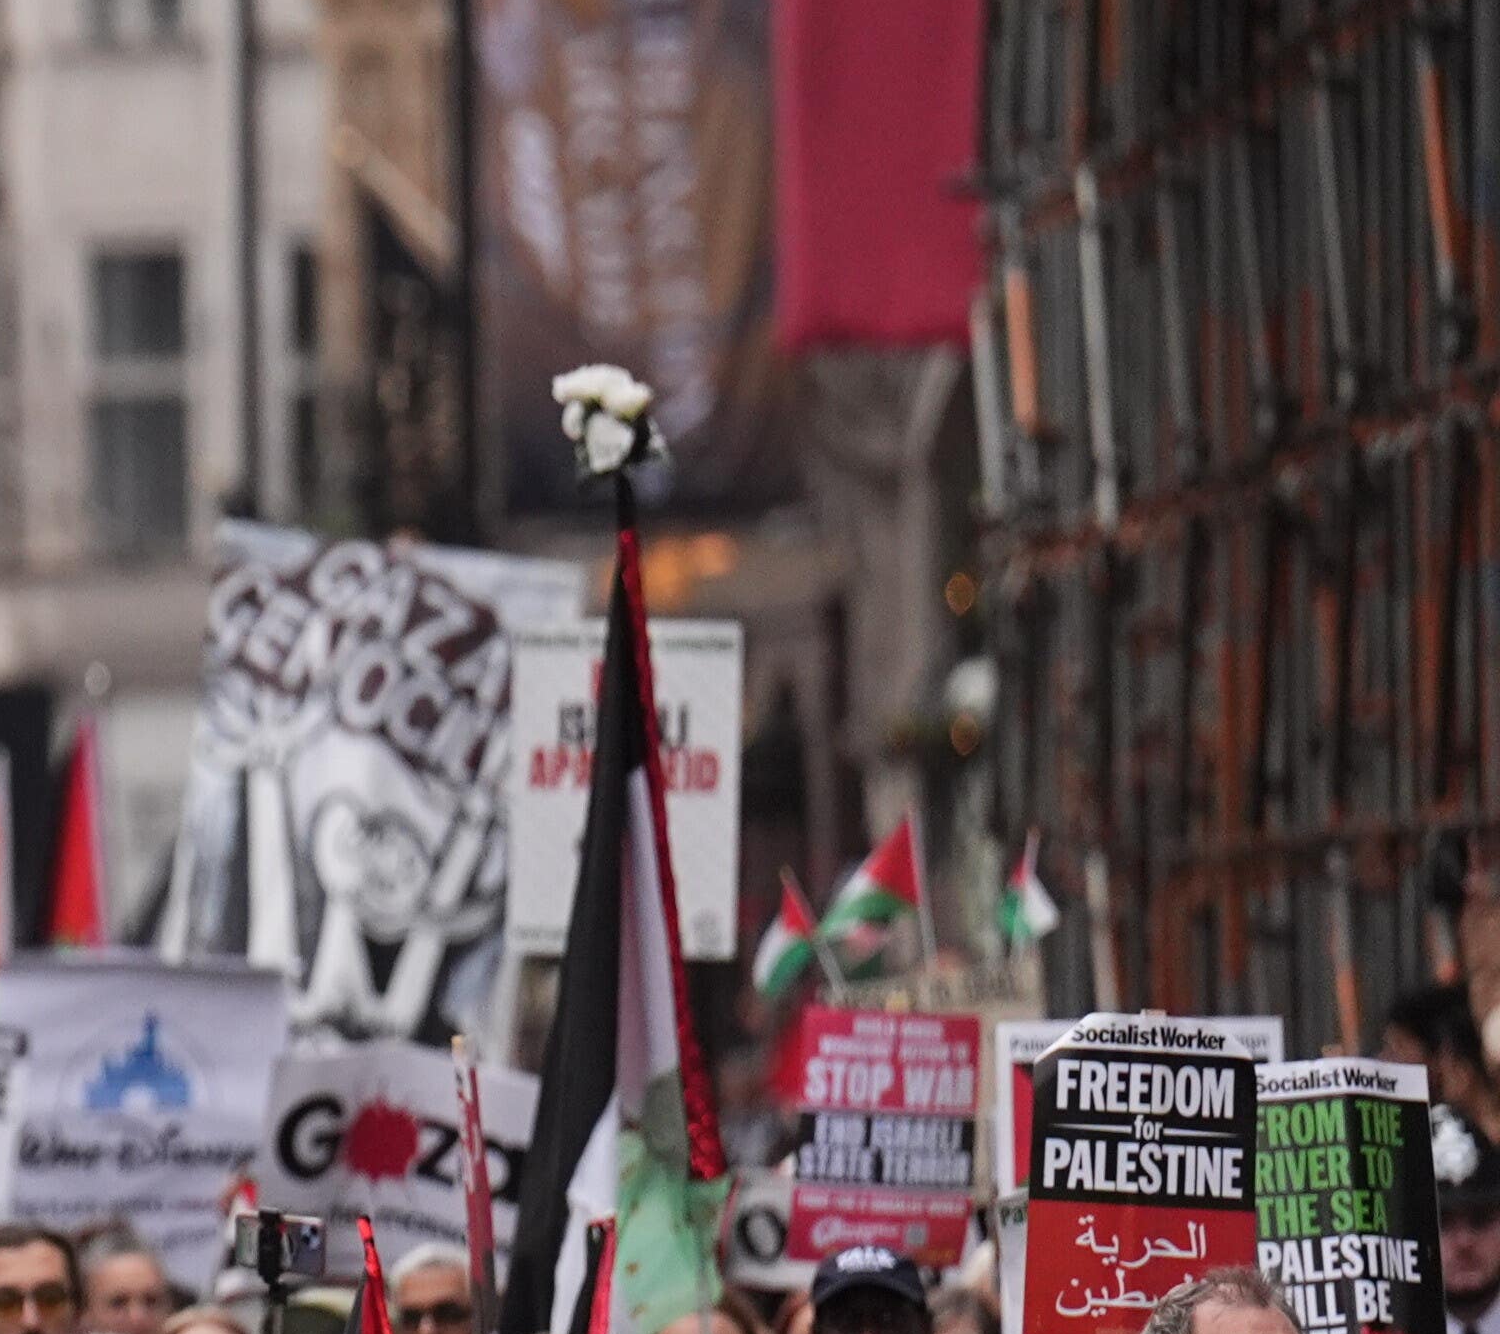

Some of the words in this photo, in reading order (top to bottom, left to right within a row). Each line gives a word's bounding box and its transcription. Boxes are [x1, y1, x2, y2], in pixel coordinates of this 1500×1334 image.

[1071, 1026, 1157, 1046] Socialist
[1160, 1028, 1226, 1051] Worker
[804, 1056, 894, 1107] STOP
[903, 1064, 975, 1108] WAR
[1056, 1059, 1235, 1119] FREEDOM
[1256, 1069, 1340, 1093] Socialist
[1342, 1067, 1398, 1092] Worker
[814, 1115, 865, 1149] END
[870, 1116, 963, 1152] ISRAELI
[1133, 1114, 1164, 1141] for
[1354, 1099, 1404, 1148] THE
[799, 1143, 874, 1180] STATE
[881, 1147, 971, 1184] TERROR
[1042, 1137, 1244, 1199] PALESTINE
[1255, 1145, 1352, 1194] RIVER
[1359, 1145, 1394, 1190] TO
[1255, 1192, 1322, 1239] THE
[1330, 1189, 1388, 1233] SEA
[1075, 1214, 1206, 1267] الحرية
[1257, 1233, 1422, 1284] PALESTINE
[1285, 1281, 1346, 1329] ILL
[1354, 1278, 1394, 1324] BE
